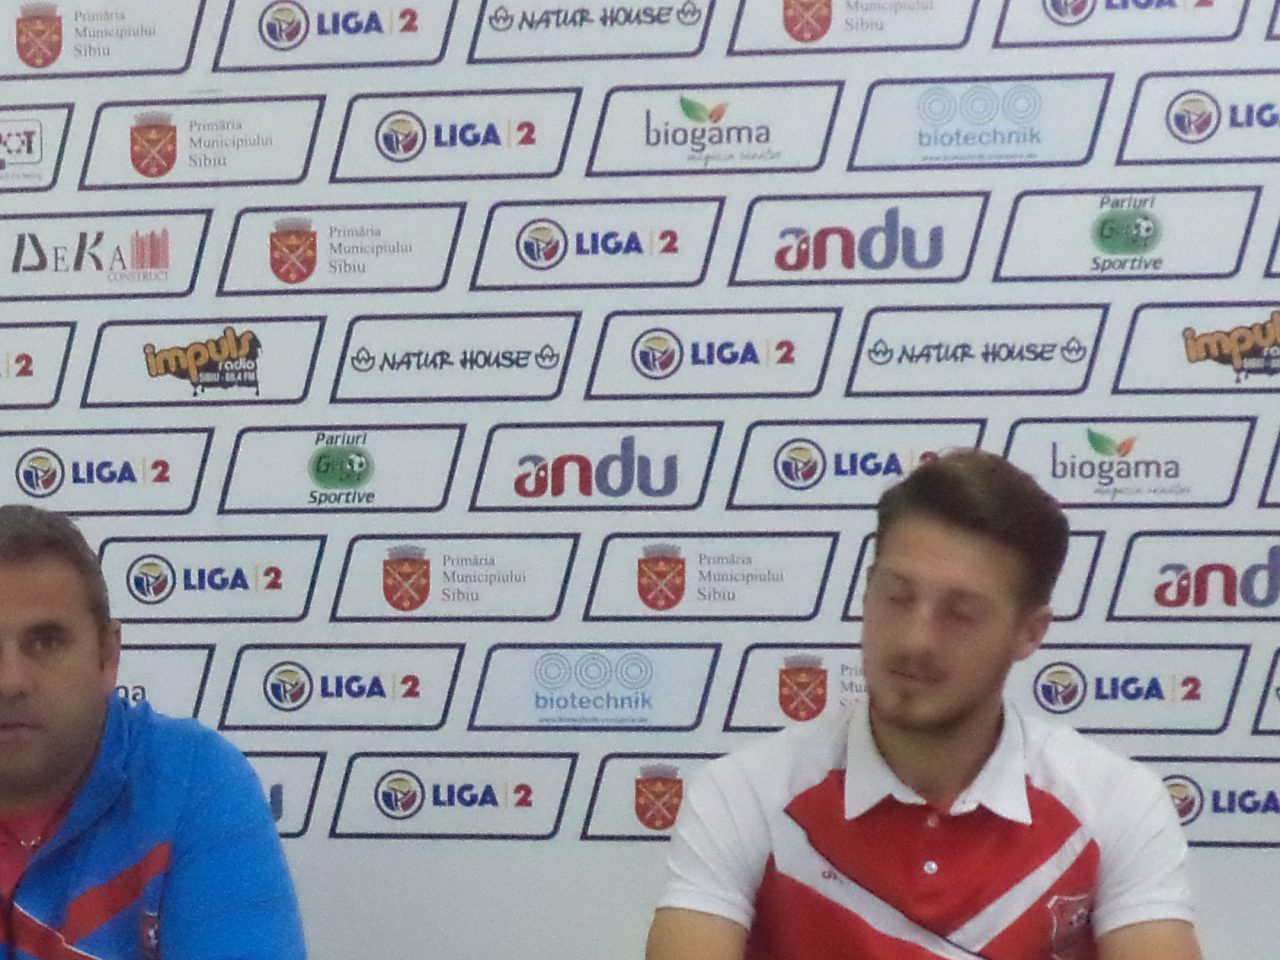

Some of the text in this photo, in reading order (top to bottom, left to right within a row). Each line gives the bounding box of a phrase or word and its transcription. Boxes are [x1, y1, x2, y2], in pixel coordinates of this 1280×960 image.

[317, 8, 418, 36] LIGA 2
[518, 6, 677, 31] NATUR HOUSE
[844, 17, 884, 32] Sibiu
[73, 41, 110, 58] Sibiu
[1229, 102, 1280, 129] LIG
[434, 121, 536, 148] LIGA 2
[645, 106, 771, 155] biogama
[916, 126, 1042, 149] biotechnik
[188, 152, 228, 169] Sibiu
[1097, 192, 1158, 211] Pariuri
[575, 229, 679, 256] LIGA 2
[774, 206, 944, 272] andu
[105, 270, 172, 283] CONSTRUCT
[327, 258, 367, 275] Sibiu
[1089, 253, 1166, 275] Sportive
[690, 340, 795, 366] LIGA 2
[897, 342, 1058, 365] NATUR HOUSE
[1182, 310, 1280, 373] impul
[14, 353, 33, 377] 2
[144, 326, 254, 385] impuls
[219, 358, 255, 370] radio
[379, 349, 535, 372] NATUR HOUSE
[243, 372, 255, 381] FM
[312, 429, 370, 448] Pariuri
[71, 459, 170, 485] LIGA 2
[514, 435, 678, 499] andu
[833, 451, 903, 477] LIGA
[1051, 438, 1180, 489] biogama
[305, 487, 378, 509] Sportive
[182, 566, 282, 592] LIGA 2
[1154, 544, 1280, 608] and
[440, 587, 480, 604] Sibiu
[694, 586, 736, 602] Sibiu
[320, 674, 420, 699] LIGA 2
[1094, 675, 1202, 701] LIGA 2
[533, 691, 654, 710] biotechnik
[432, 783, 533, 808] LIGA 2
